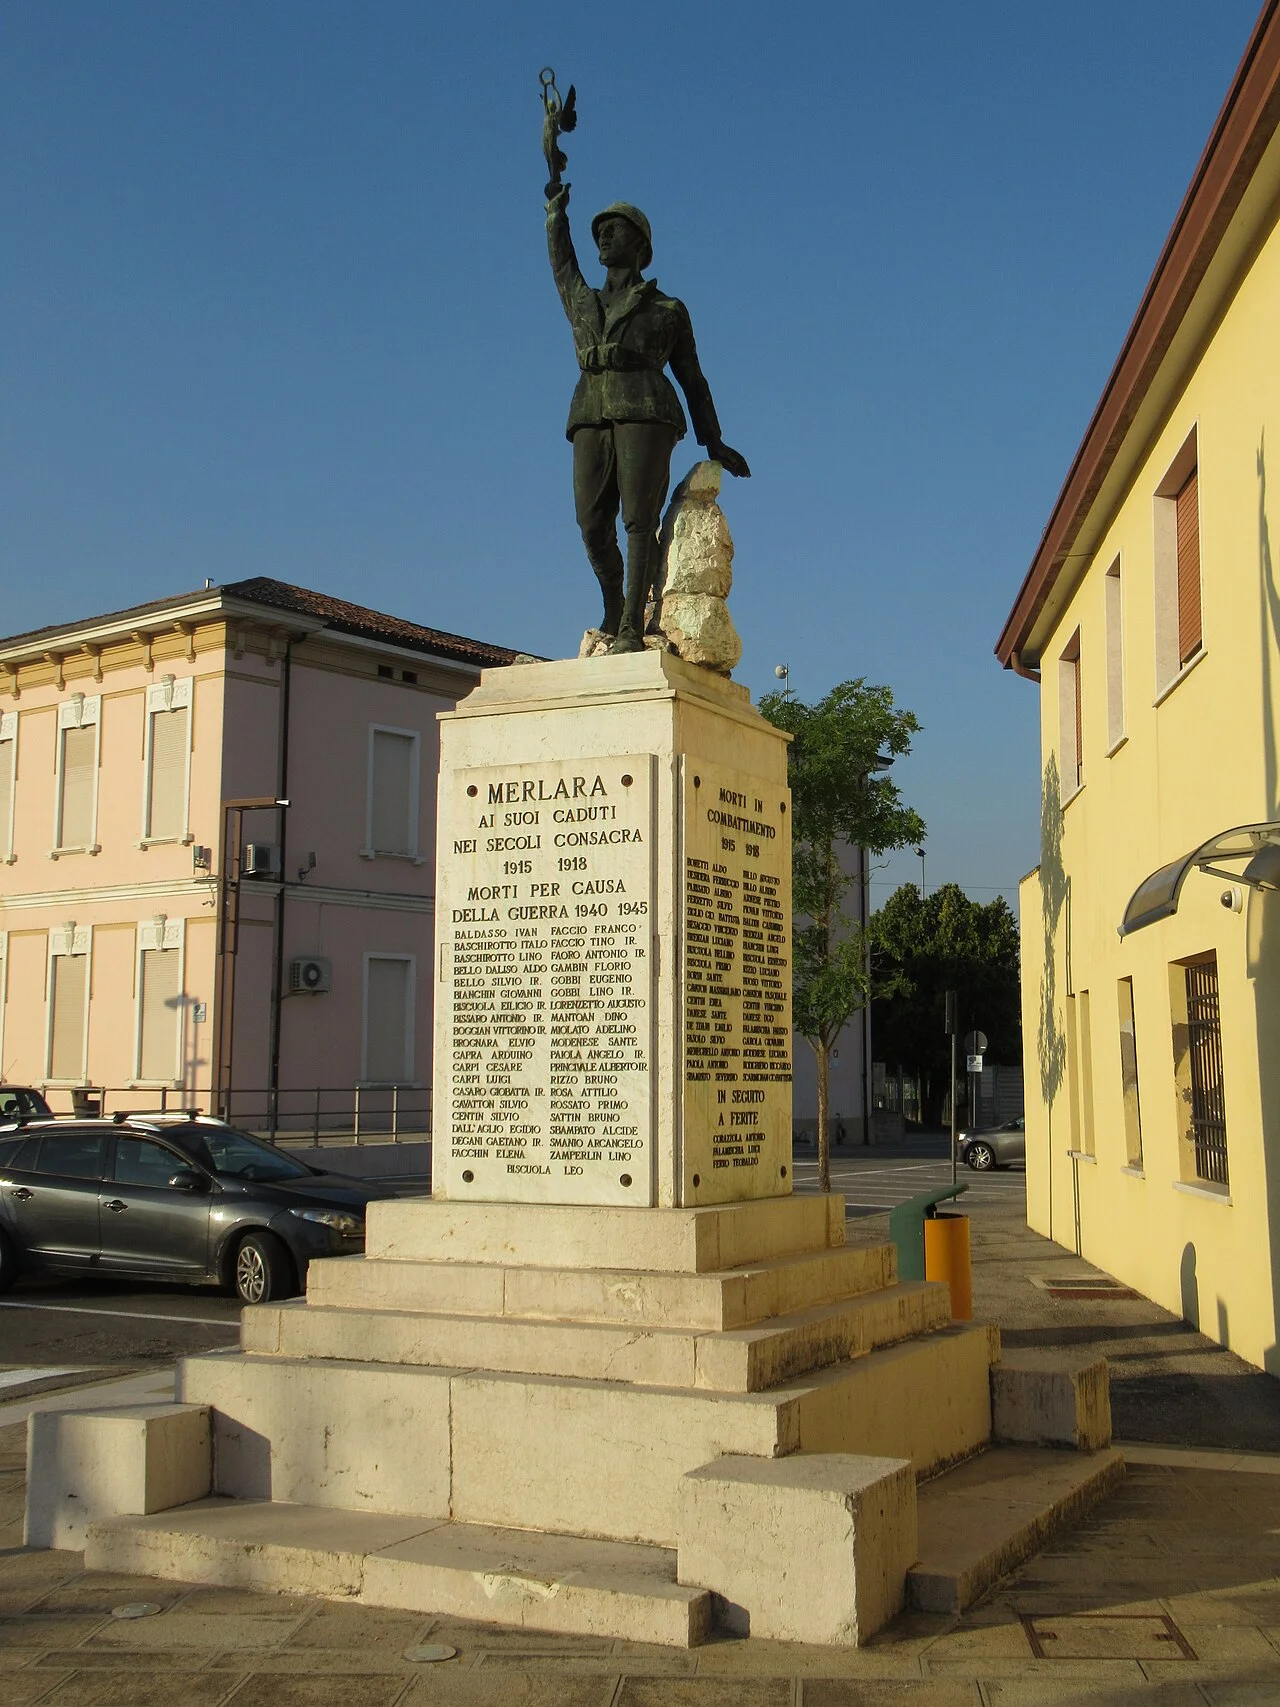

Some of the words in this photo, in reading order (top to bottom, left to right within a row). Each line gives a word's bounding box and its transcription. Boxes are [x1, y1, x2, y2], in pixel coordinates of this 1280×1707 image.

[488, 775, 607, 804] MERLARA
[719, 788, 746, 808] MORTI
[754, 799, 762, 812] IN
[478, 814, 494, 828] AI
[504, 811, 539, 826] SUOI
[553, 806, 616, 823] CADUTI
[707, 809, 775, 839] COMBATTIMENTO
[454, 840, 477, 854] NEI
[486, 835, 541, 851] SECOLI
[554, 829, 643, 847] CONSACRA
[721, 838, 735, 852] 1915
[745, 844, 759, 858] 1918
[504, 861, 532, 874] 1915
[558, 857, 587, 871] 1918
[468, 885, 518, 900] MORTI
[530, 882, 560, 897] PER
[572, 879, 626, 895] CAUSA
[452, 908, 500, 923] DELLA
[508, 905, 569, 920] GUERRA
[575, 903, 608, 917] 1940
[618, 902, 647, 915] 1945
[454, 929, 507, 939] BALDASSO
[515, 928, 537, 937] IVAN
[551, 926, 587, 935] FACCIO
[594, 924, 636, 934] FRANCO
[454, 941, 517, 951] BASCHIROTTO
[521, 940, 548, 949] ITALO
[551, 938, 585, 947] FACCIO
[590, 937, 615, 946] TINO
[454, 953, 514, 963] BASCHIROTTO
[519, 952, 542, 961] LINO
[551, 951, 580, 960] FAORO
[585, 950, 627, 959] ANTONIO
[454, 966, 482, 975] BELLO
[485, 966, 518, 974] DALISO
[523, 964, 547, 973] ALDO
[551, 963, 588, 972] GAMBIN
[594, 962, 631, 971] FLORIO
[454, 978, 485, 987] BELLO
[492, 977, 522, 986] SILVIO
[551, 976, 580, 984] GOBBI
[589, 974, 632, 983] EUGENIO
[454, 990, 495, 999] BIANCHIN
[500, 989, 541, 998] GIOVANNI
[550, 988, 580, 997] GOBBI
[589, 987, 613, 996] LINO
[454, 1002, 495, 1011] BISCUOLA
[550, 1000, 604, 1010] LORENZETTO
[607, 999, 645, 1008] AUGUSTO
[454, 1015, 487, 1023] BISSARO
[490, 1014, 526, 1022] ANTONIO
[551, 1013, 594, 1022] MANTOAN
[605, 1012, 627, 1021] DINO
[453, 1027, 490, 1035] BOGGIAN
[493, 1026, 536, 1035] VITTORINO
[551, 1025, 589, 1034] MIOLATO
[595, 1025, 636, 1034] ADELINO
[453, 1039, 498, 1047] BROGNARA
[509, 1038, 535, 1047] ELVIO
[551, 1038, 599, 1047] MODENESE
[608, 1038, 637, 1046] SANTE
[453, 1051, 482, 1059] CAPRA
[491, 1051, 532, 1059] ARDUINO
[550, 1050, 582, 1059] PAIOLA
[587, 1050, 624, 1059] ANGELO
[453, 1063, 479, 1071] CARPI
[486, 1063, 522, 1071] CESARE
[453, 1075, 480, 1084] CARPI
[486, 1075, 511, 1084] LUIGI
[550, 1076, 578, 1084] RIZZO
[585, 1075, 617, 1084] BRUNO
[453, 1088, 486, 1096] CASARO
[550, 1088, 573, 1096] ROSA
[581, 1088, 617, 1096] ATTILIO
[718, 1090, 726, 1103] IN
[732, 1090, 765, 1103] SEGUITO
[500, 1100, 528, 1109] SILVIO
[550, 1101, 590, 1109] ROSSATO
[598, 1101, 628, 1109] PRIMO
[452, 1112, 483, 1121] CENTIN
[491, 1112, 519, 1121] SILVIO
[550, 1113, 580, 1122] SATTIN
[588, 1113, 620, 1122] BRUNO
[718, 1112, 724, 1126] A
[730, 1112, 758, 1126] FERITE
[510, 1125, 541, 1134] EGIDIO
[550, 1126, 595, 1135] SBAMPATO
[602, 1126, 638, 1135] ALCIDE
[452, 1137, 482, 1146] DEGANI
[486, 1137, 527, 1146] GAETANO
[550, 1138, 583, 1147] SMANIO
[587, 1139, 643, 1148] ARCANGELO
[452, 1149, 488, 1158] FACCHIN
[496, 1150, 525, 1159] ELENA
[550, 1151, 602, 1160] ZAMPERLIN
[609, 1152, 631, 1161] LINO
[507, 1165, 551, 1174] BISCUOLA
[564, 1166, 583, 1175] LEO
